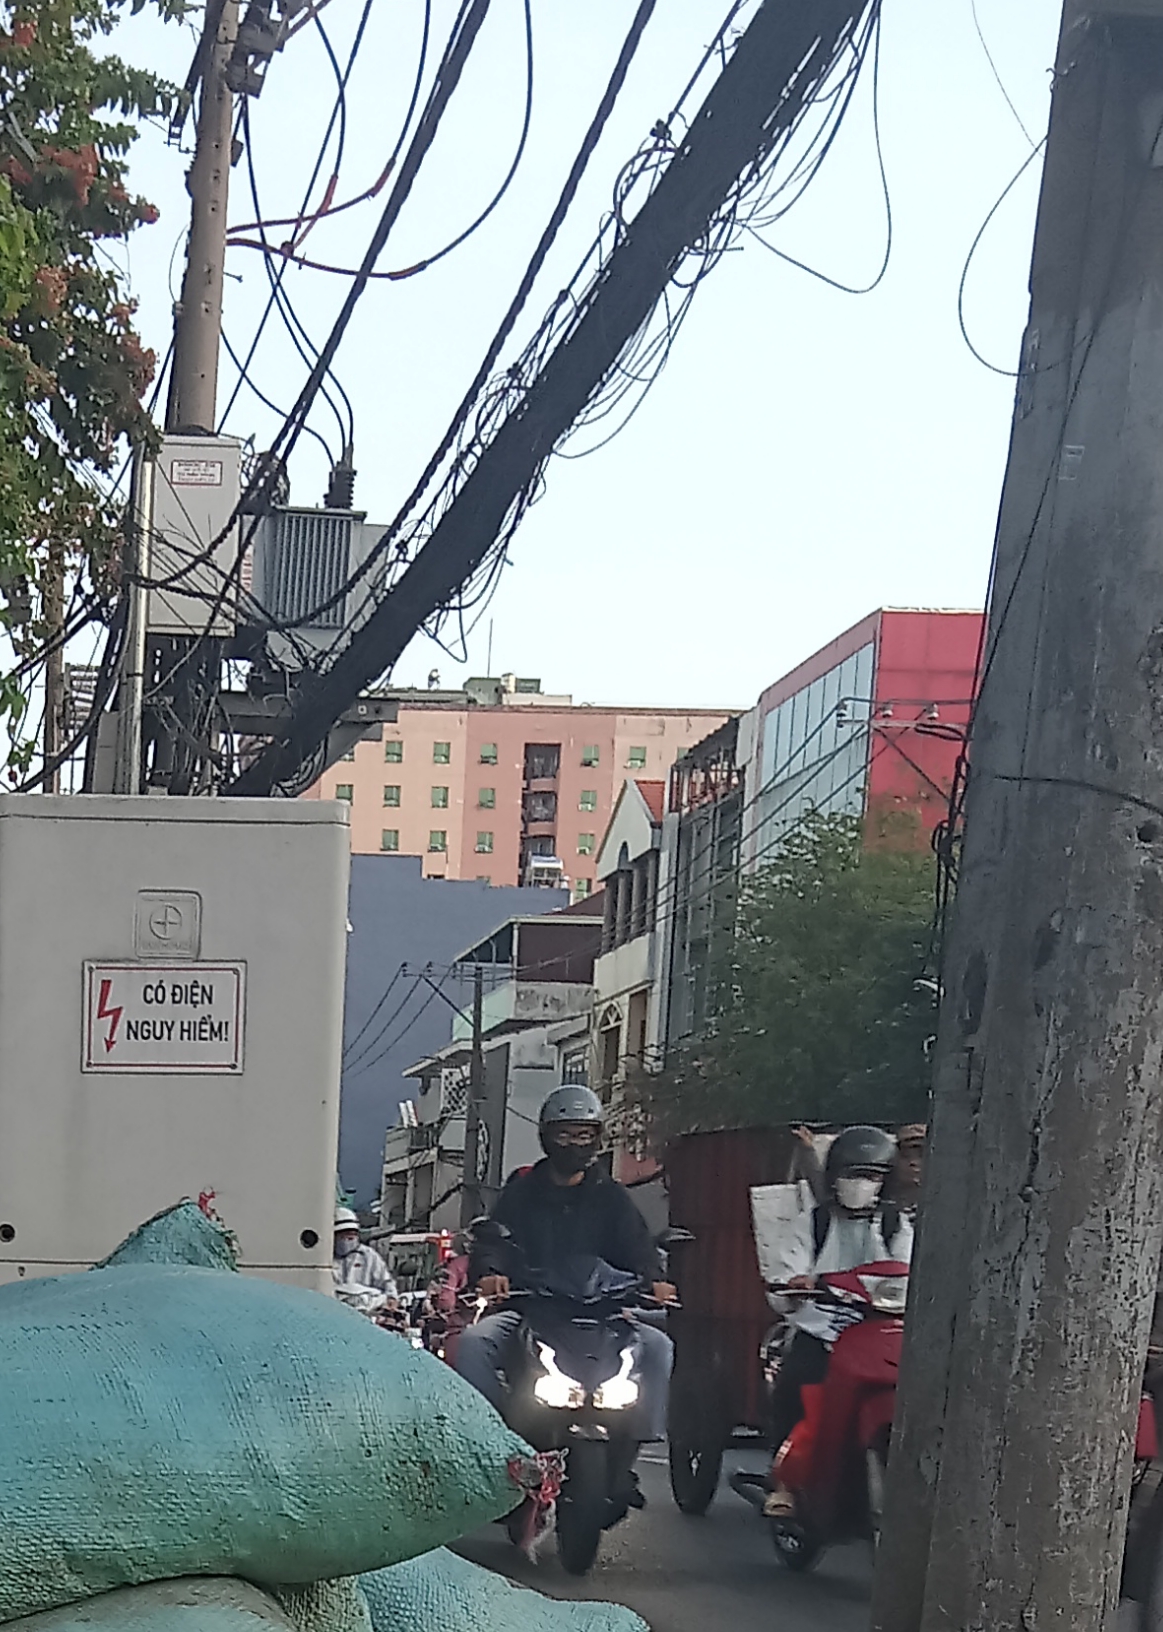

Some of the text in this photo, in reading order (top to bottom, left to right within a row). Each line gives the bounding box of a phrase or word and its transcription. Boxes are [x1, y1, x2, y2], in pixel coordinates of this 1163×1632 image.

[143, 979, 213, 1009] CÓ ĐIỆN
[126, 1014, 229, 1042] NGUY HIỂM!
